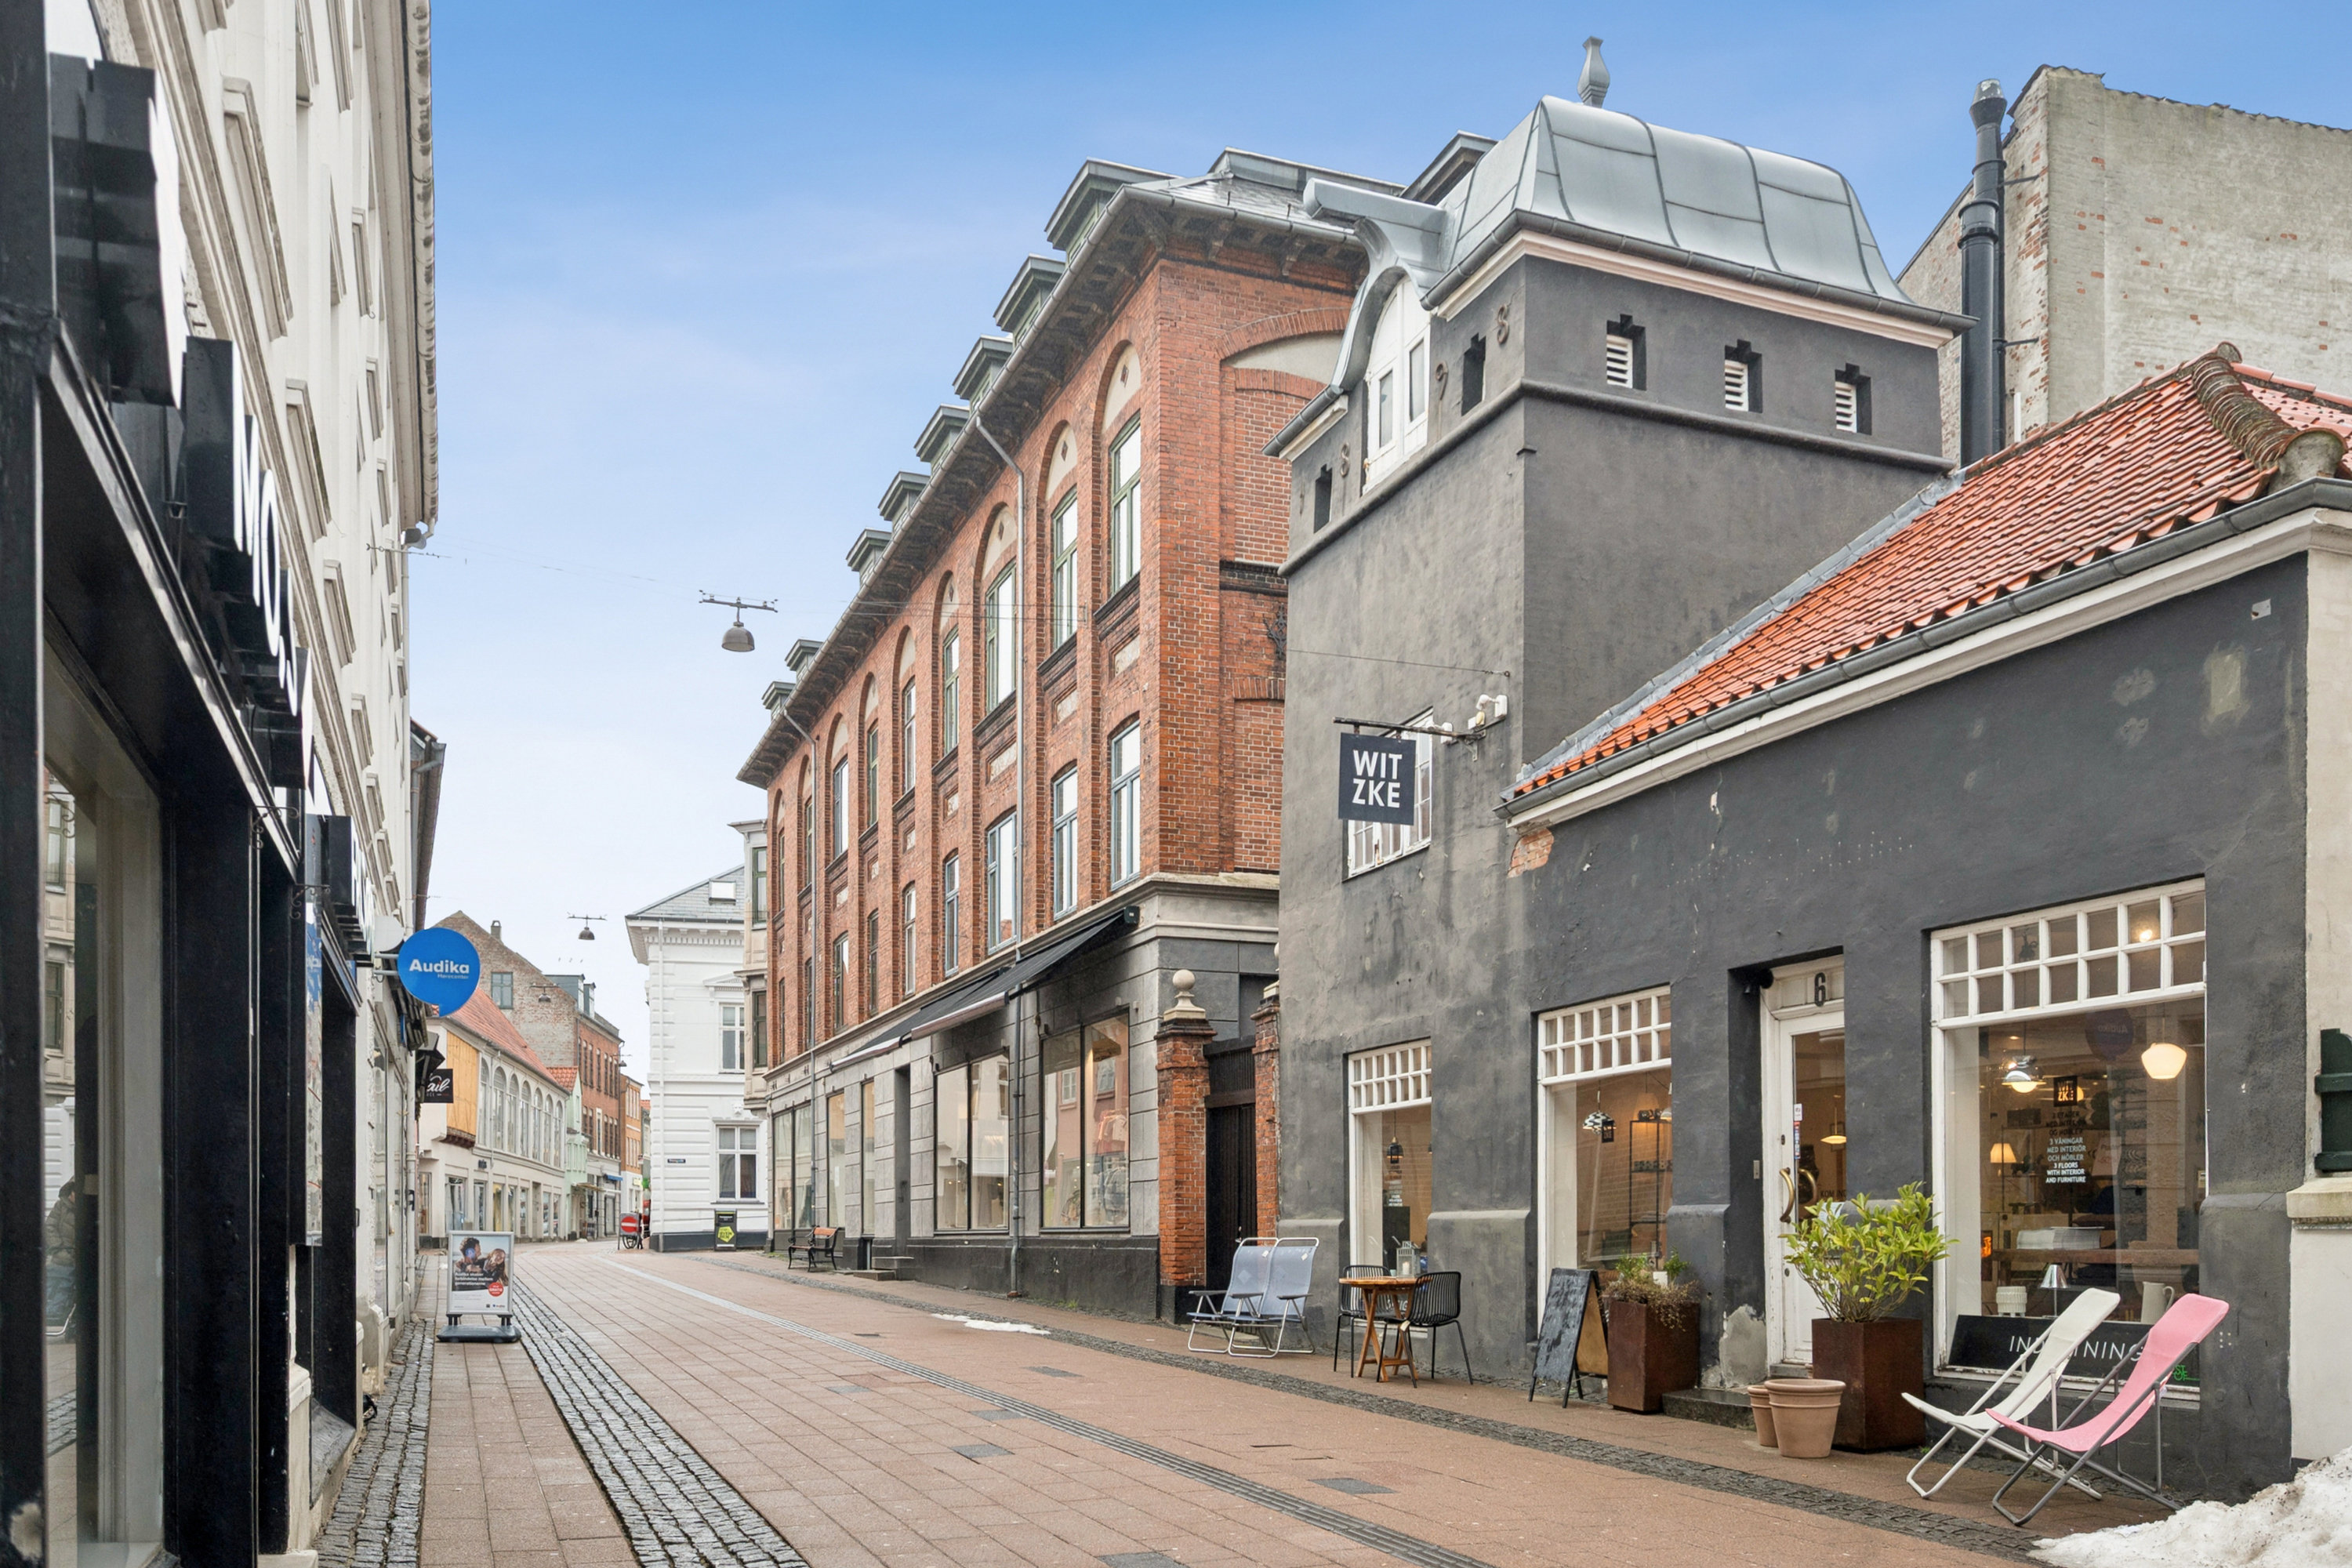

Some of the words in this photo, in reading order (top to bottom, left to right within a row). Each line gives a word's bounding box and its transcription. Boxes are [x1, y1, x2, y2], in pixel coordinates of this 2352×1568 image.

[1353, 750, 1403, 779] WIT
[1352, 778, 1401, 808] ZKE
[409, 959, 470, 974] Audika
[1814, 972, 1826, 1007] 6
[426, 1073, 451, 1092] ail
